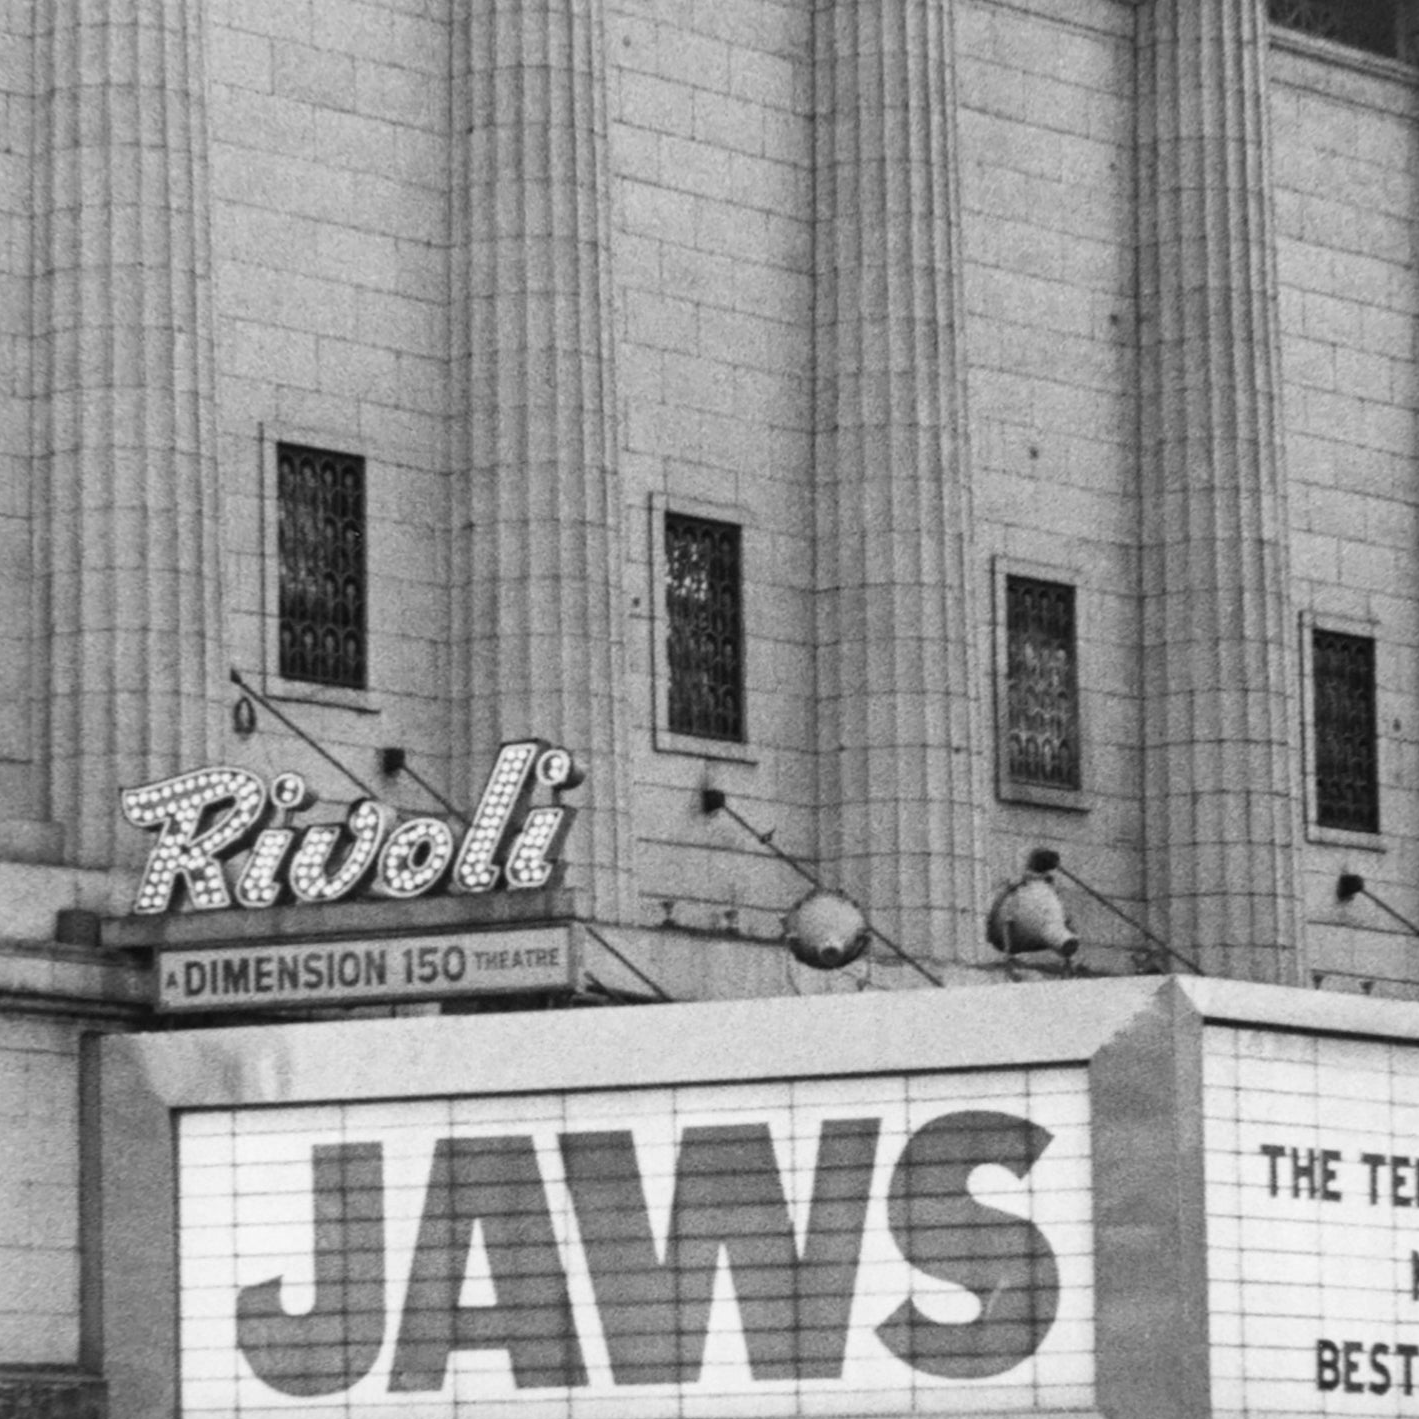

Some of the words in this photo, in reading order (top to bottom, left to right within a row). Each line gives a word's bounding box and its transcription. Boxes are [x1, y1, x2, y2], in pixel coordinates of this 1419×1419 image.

[121, 740, 573, 914] Rivoli
[184, 949, 387, 997] DIMENSION
[404, 945, 466, 985] 150
[473, 946, 561, 972] THEATRE
[1259, 1144, 1342, 1203] THE
[236, 1110, 1061, 1397] JAWS
[1315, 1340, 1419, 1398] BEST
